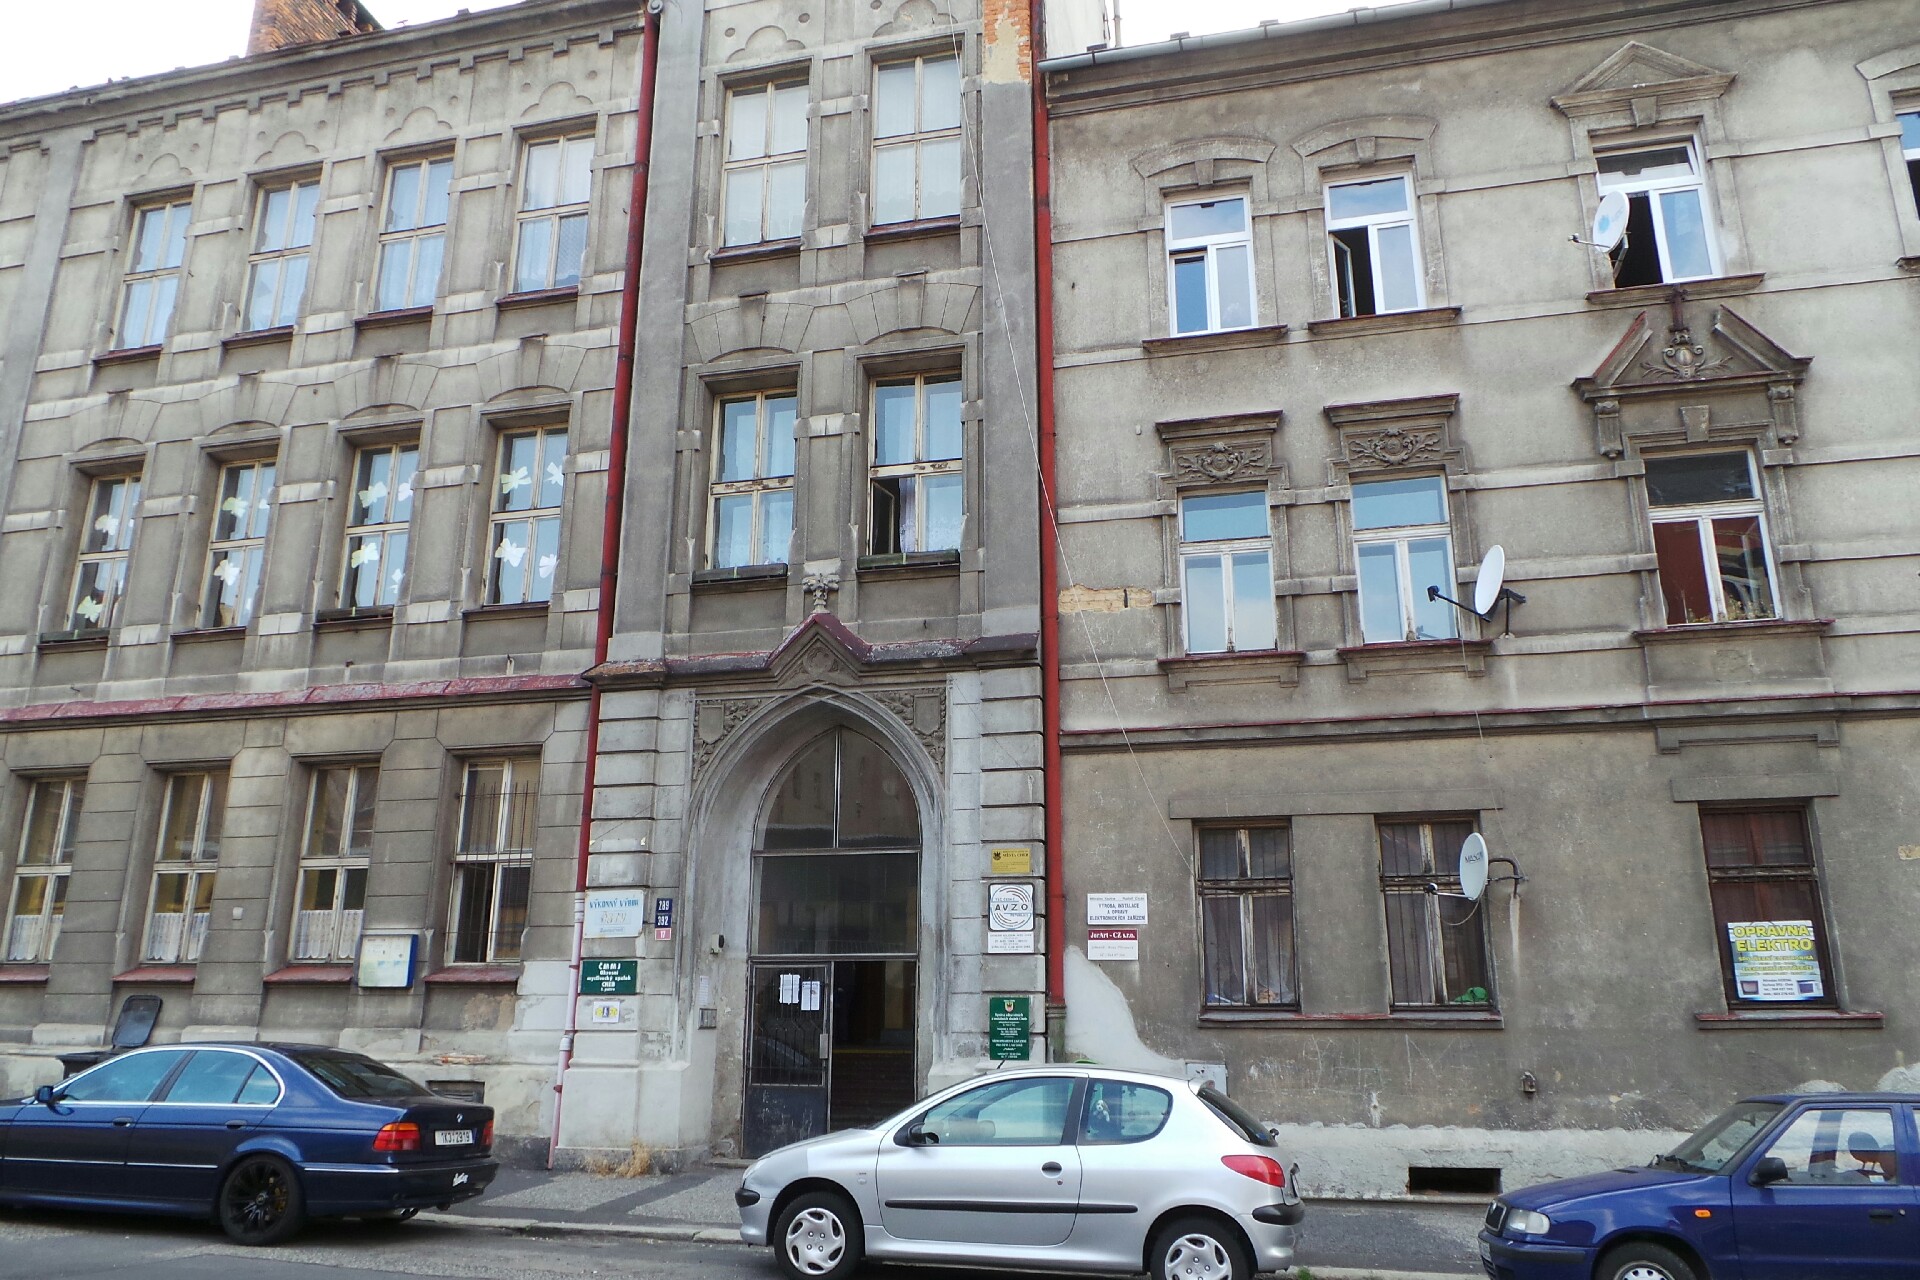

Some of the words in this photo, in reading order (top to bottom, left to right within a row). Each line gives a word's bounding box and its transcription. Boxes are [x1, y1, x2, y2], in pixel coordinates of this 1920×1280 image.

[589, 898, 618, 909] VÝKONNÝ
[1733, 925, 1809, 937] OPRAVNA
[1736, 938, 1812, 952] ELEKTRO
